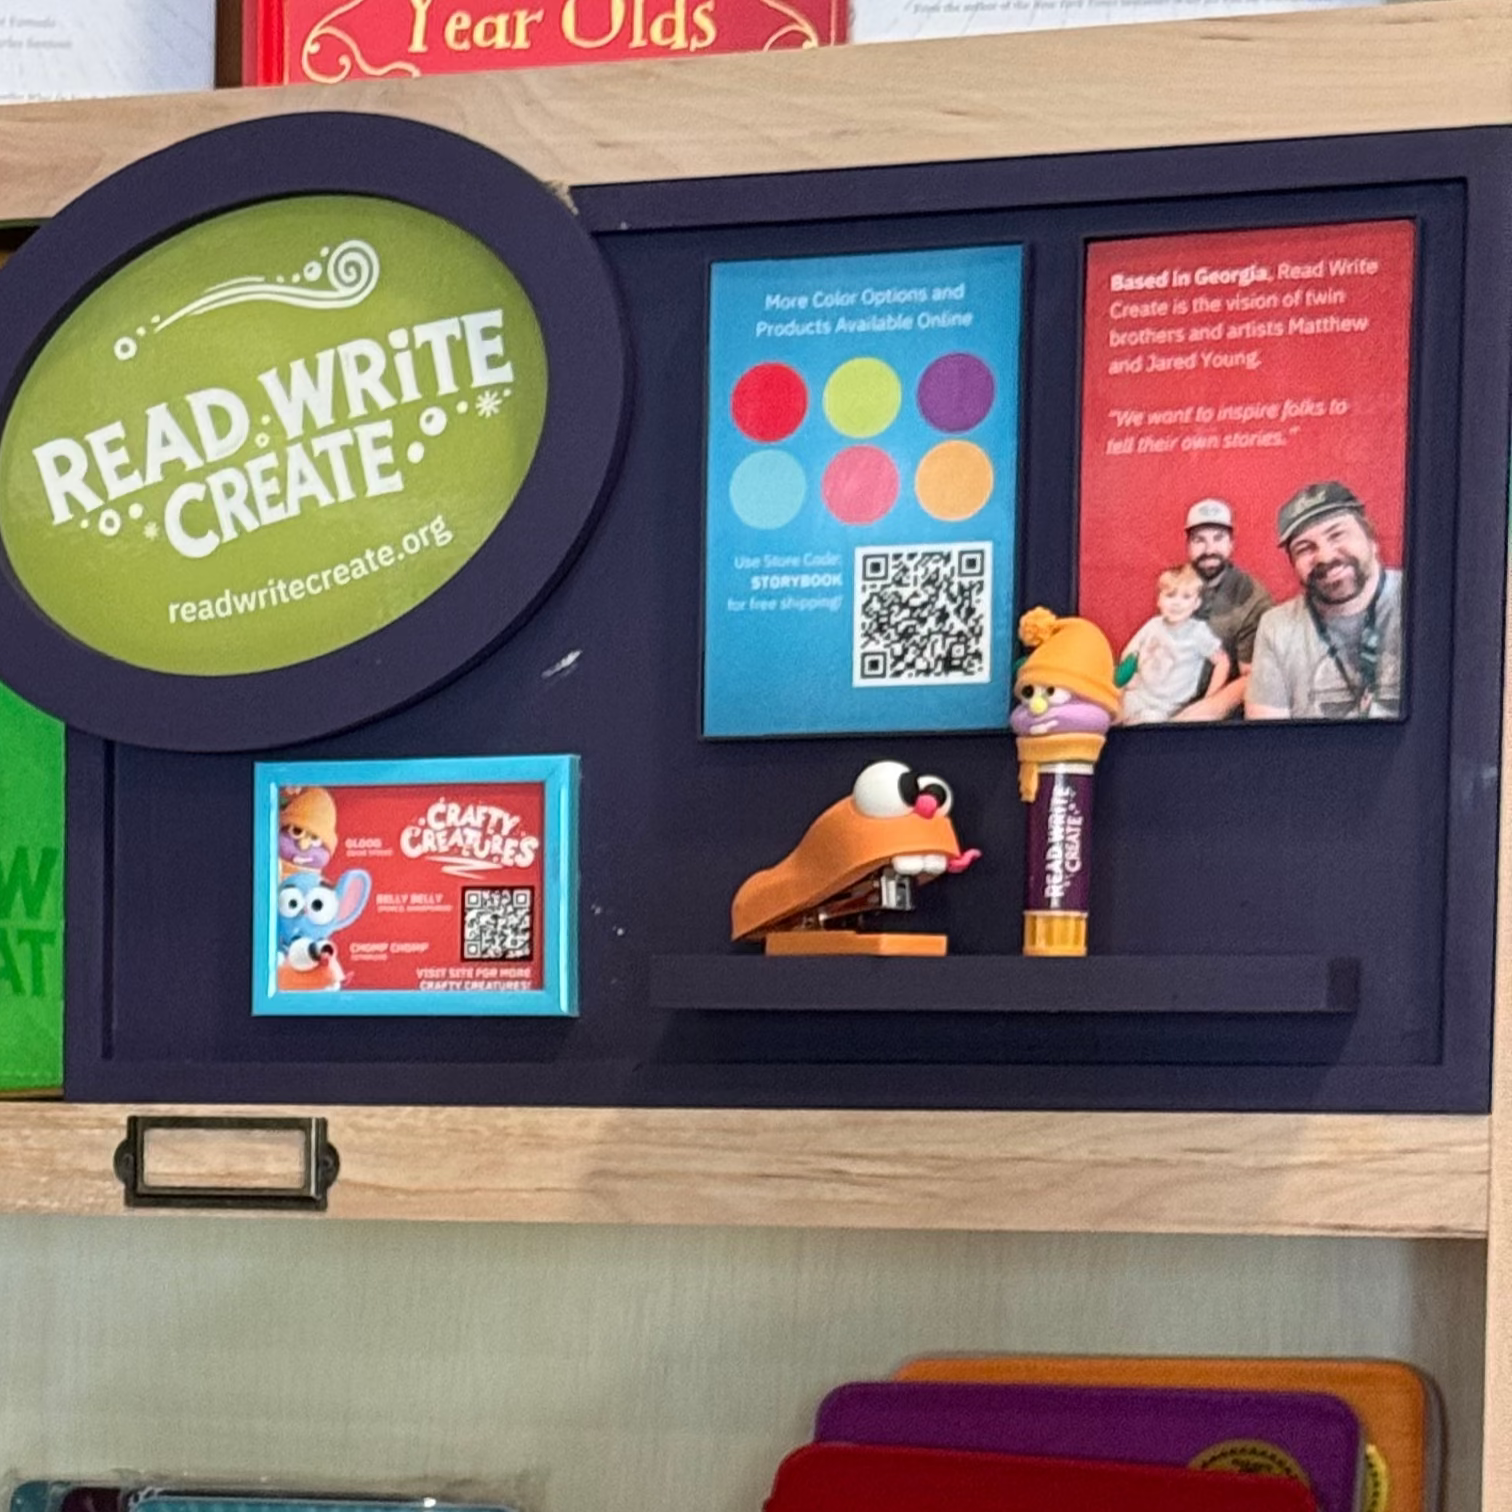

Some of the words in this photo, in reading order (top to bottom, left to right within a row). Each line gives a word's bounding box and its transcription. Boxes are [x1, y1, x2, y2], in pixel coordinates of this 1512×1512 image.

[408, 0, 544, 52] Year
[560, 0, 718, 51] Olds
[1110, 269, 1169, 292] Based
[1172, 268, 1191, 288] in
[1277, 260, 1325, 280] Read
[1327, 256, 1380, 278] Write
[765, 291, 809, 311] More
[812, 288, 857, 309] Color
[860, 285, 929, 308] Options
[932, 283, 966, 301] and
[1109, 299, 1169, 320] Create
[1171, 297, 1189, 316] is
[1192, 293, 1223, 314] the
[1224, 291, 1279, 312] vision
[1281, 288, 1303, 309] of
[1304, 287, 1347, 306] twin
[755, 317, 832, 338] Products
[835, 311, 915, 334] Available
[917, 310, 974, 330] Online
[1109, 326, 1185, 348] brothers
[1188, 322, 1223, 342] and
[1225, 318, 1285, 341] artists
[1287, 314, 1370, 336] Matthew
[1108, 354, 1143, 376] and
[1145, 352, 1197, 374] Jared
[1147, 406, 1192, 426] want
[1195, 404, 1214, 424] to
[1216, 402, 1279, 427] inspire
[1280, 398, 1326, 422] folks
[1328, 397, 1350, 416] to
[32, 387, 251, 526] READ
[1105, 436, 1135, 457] tell
[1137, 433, 1179, 454] their
[1180, 433, 1220, 452] own
[164, 419, 404, 559] CREATE
[168, 514, 453, 625] readwritecreate.org
[750, 571, 844, 591] STORYBOOK
[750, 596, 785, 612] free
[426, 798, 522, 838] CRAFTY
[399, 823, 540, 870] CREATURES
[1064, 814, 1084, 874] CREATE
[1044, 842, 1065, 898] READ
[499, 968, 532, 980] MORE
